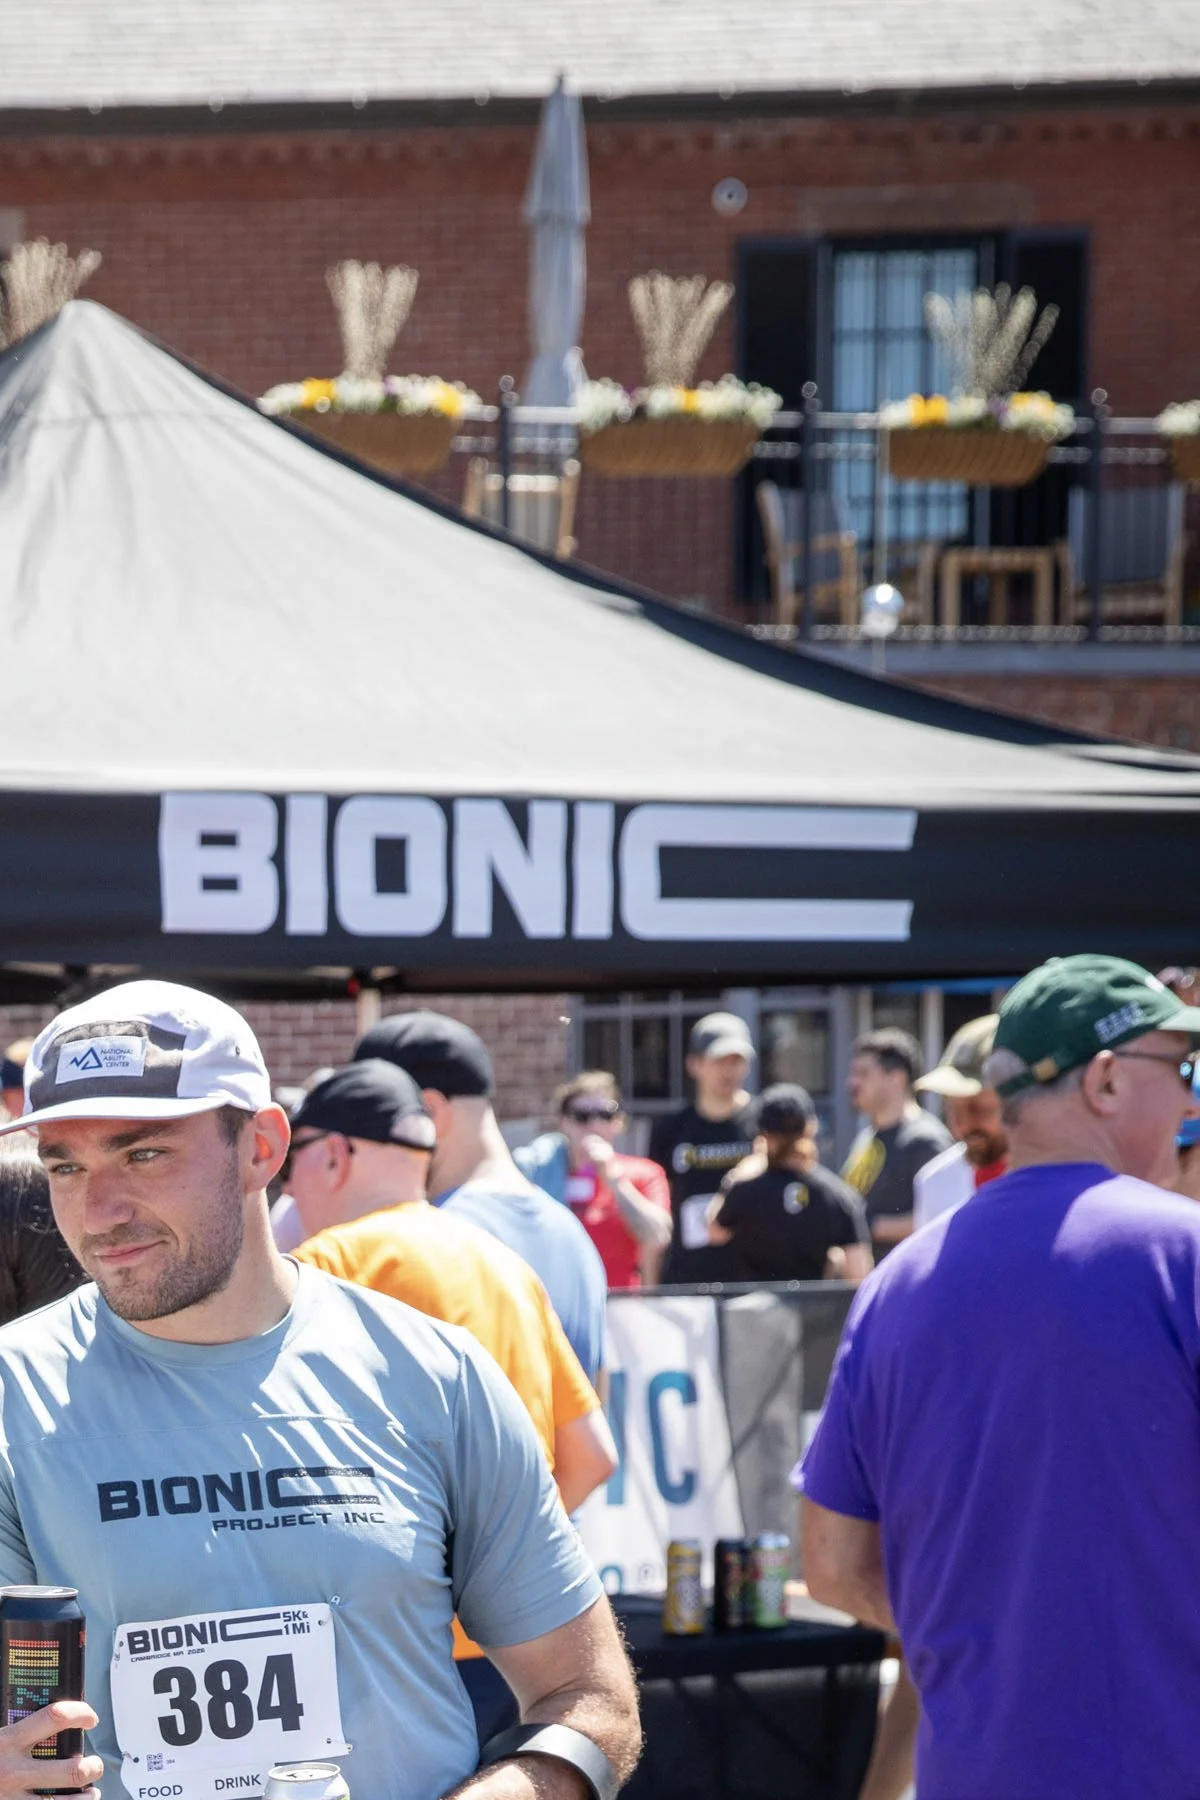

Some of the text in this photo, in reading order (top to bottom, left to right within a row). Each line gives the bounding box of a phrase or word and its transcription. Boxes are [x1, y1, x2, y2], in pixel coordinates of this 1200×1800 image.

[158, 790, 918, 942] BIONIC
[96, 1466, 381, 1523] BIONIC
[212, 1511, 385, 1532] PROJECT INC
[127, 1612, 282, 1655] BIONIC
[130, 1651, 171, 1663] CAMBRIDGE
[153, 1652, 304, 1747] 384
[139, 1774, 262, 1798] FOOD DRINK
